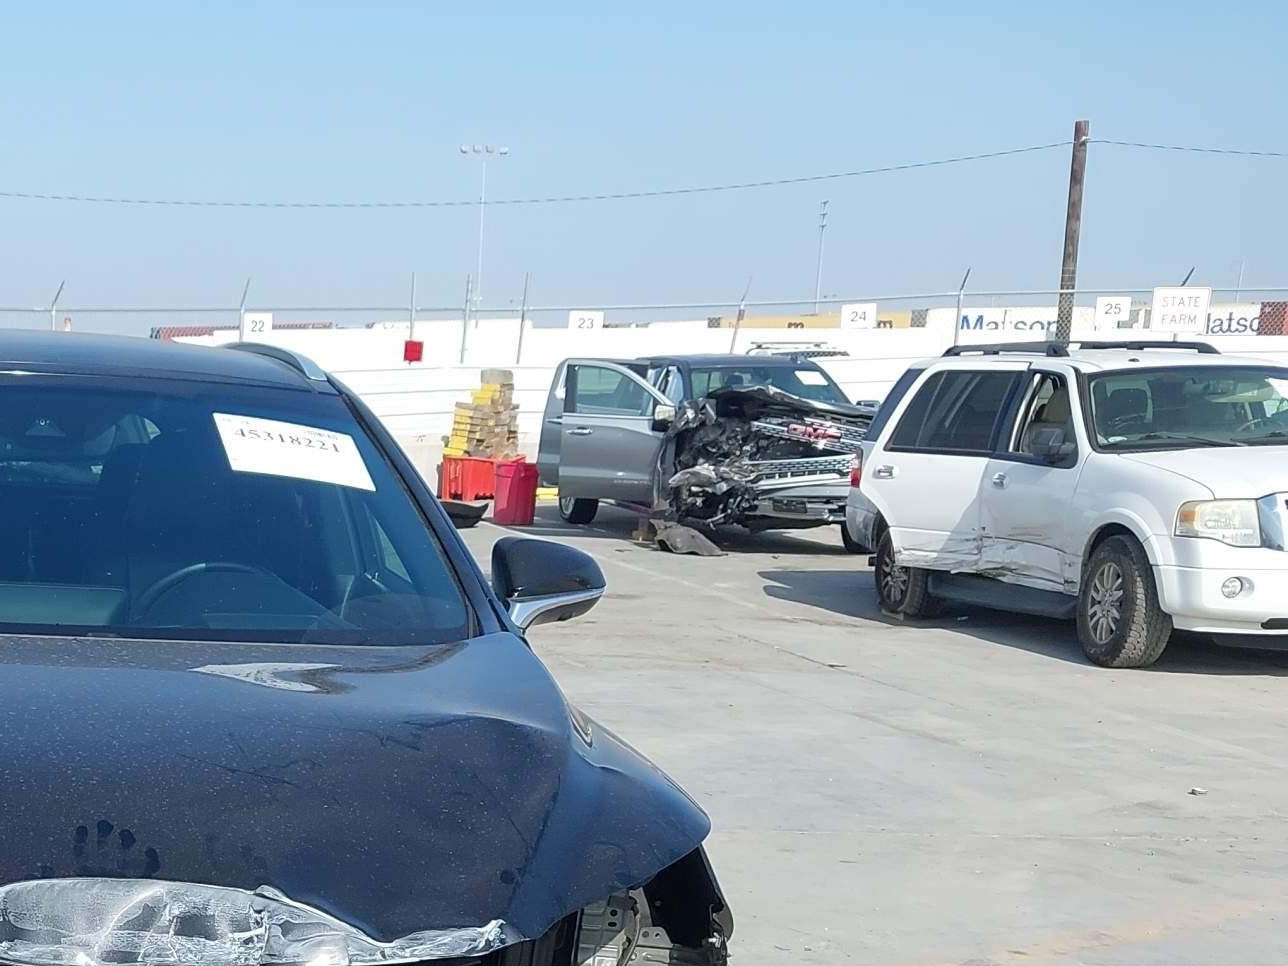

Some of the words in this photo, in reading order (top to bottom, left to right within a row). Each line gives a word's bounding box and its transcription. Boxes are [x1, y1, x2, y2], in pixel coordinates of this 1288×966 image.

[1161, 296, 1202, 308] STATE
[1103, 303, 1122, 315] 25
[849, 310, 867, 322] 24
[1160, 313, 1198, 326] FARM
[250, 319, 265, 333] 22
[577, 317, 594, 329] 23
[234, 427, 340, 453] 45318221
